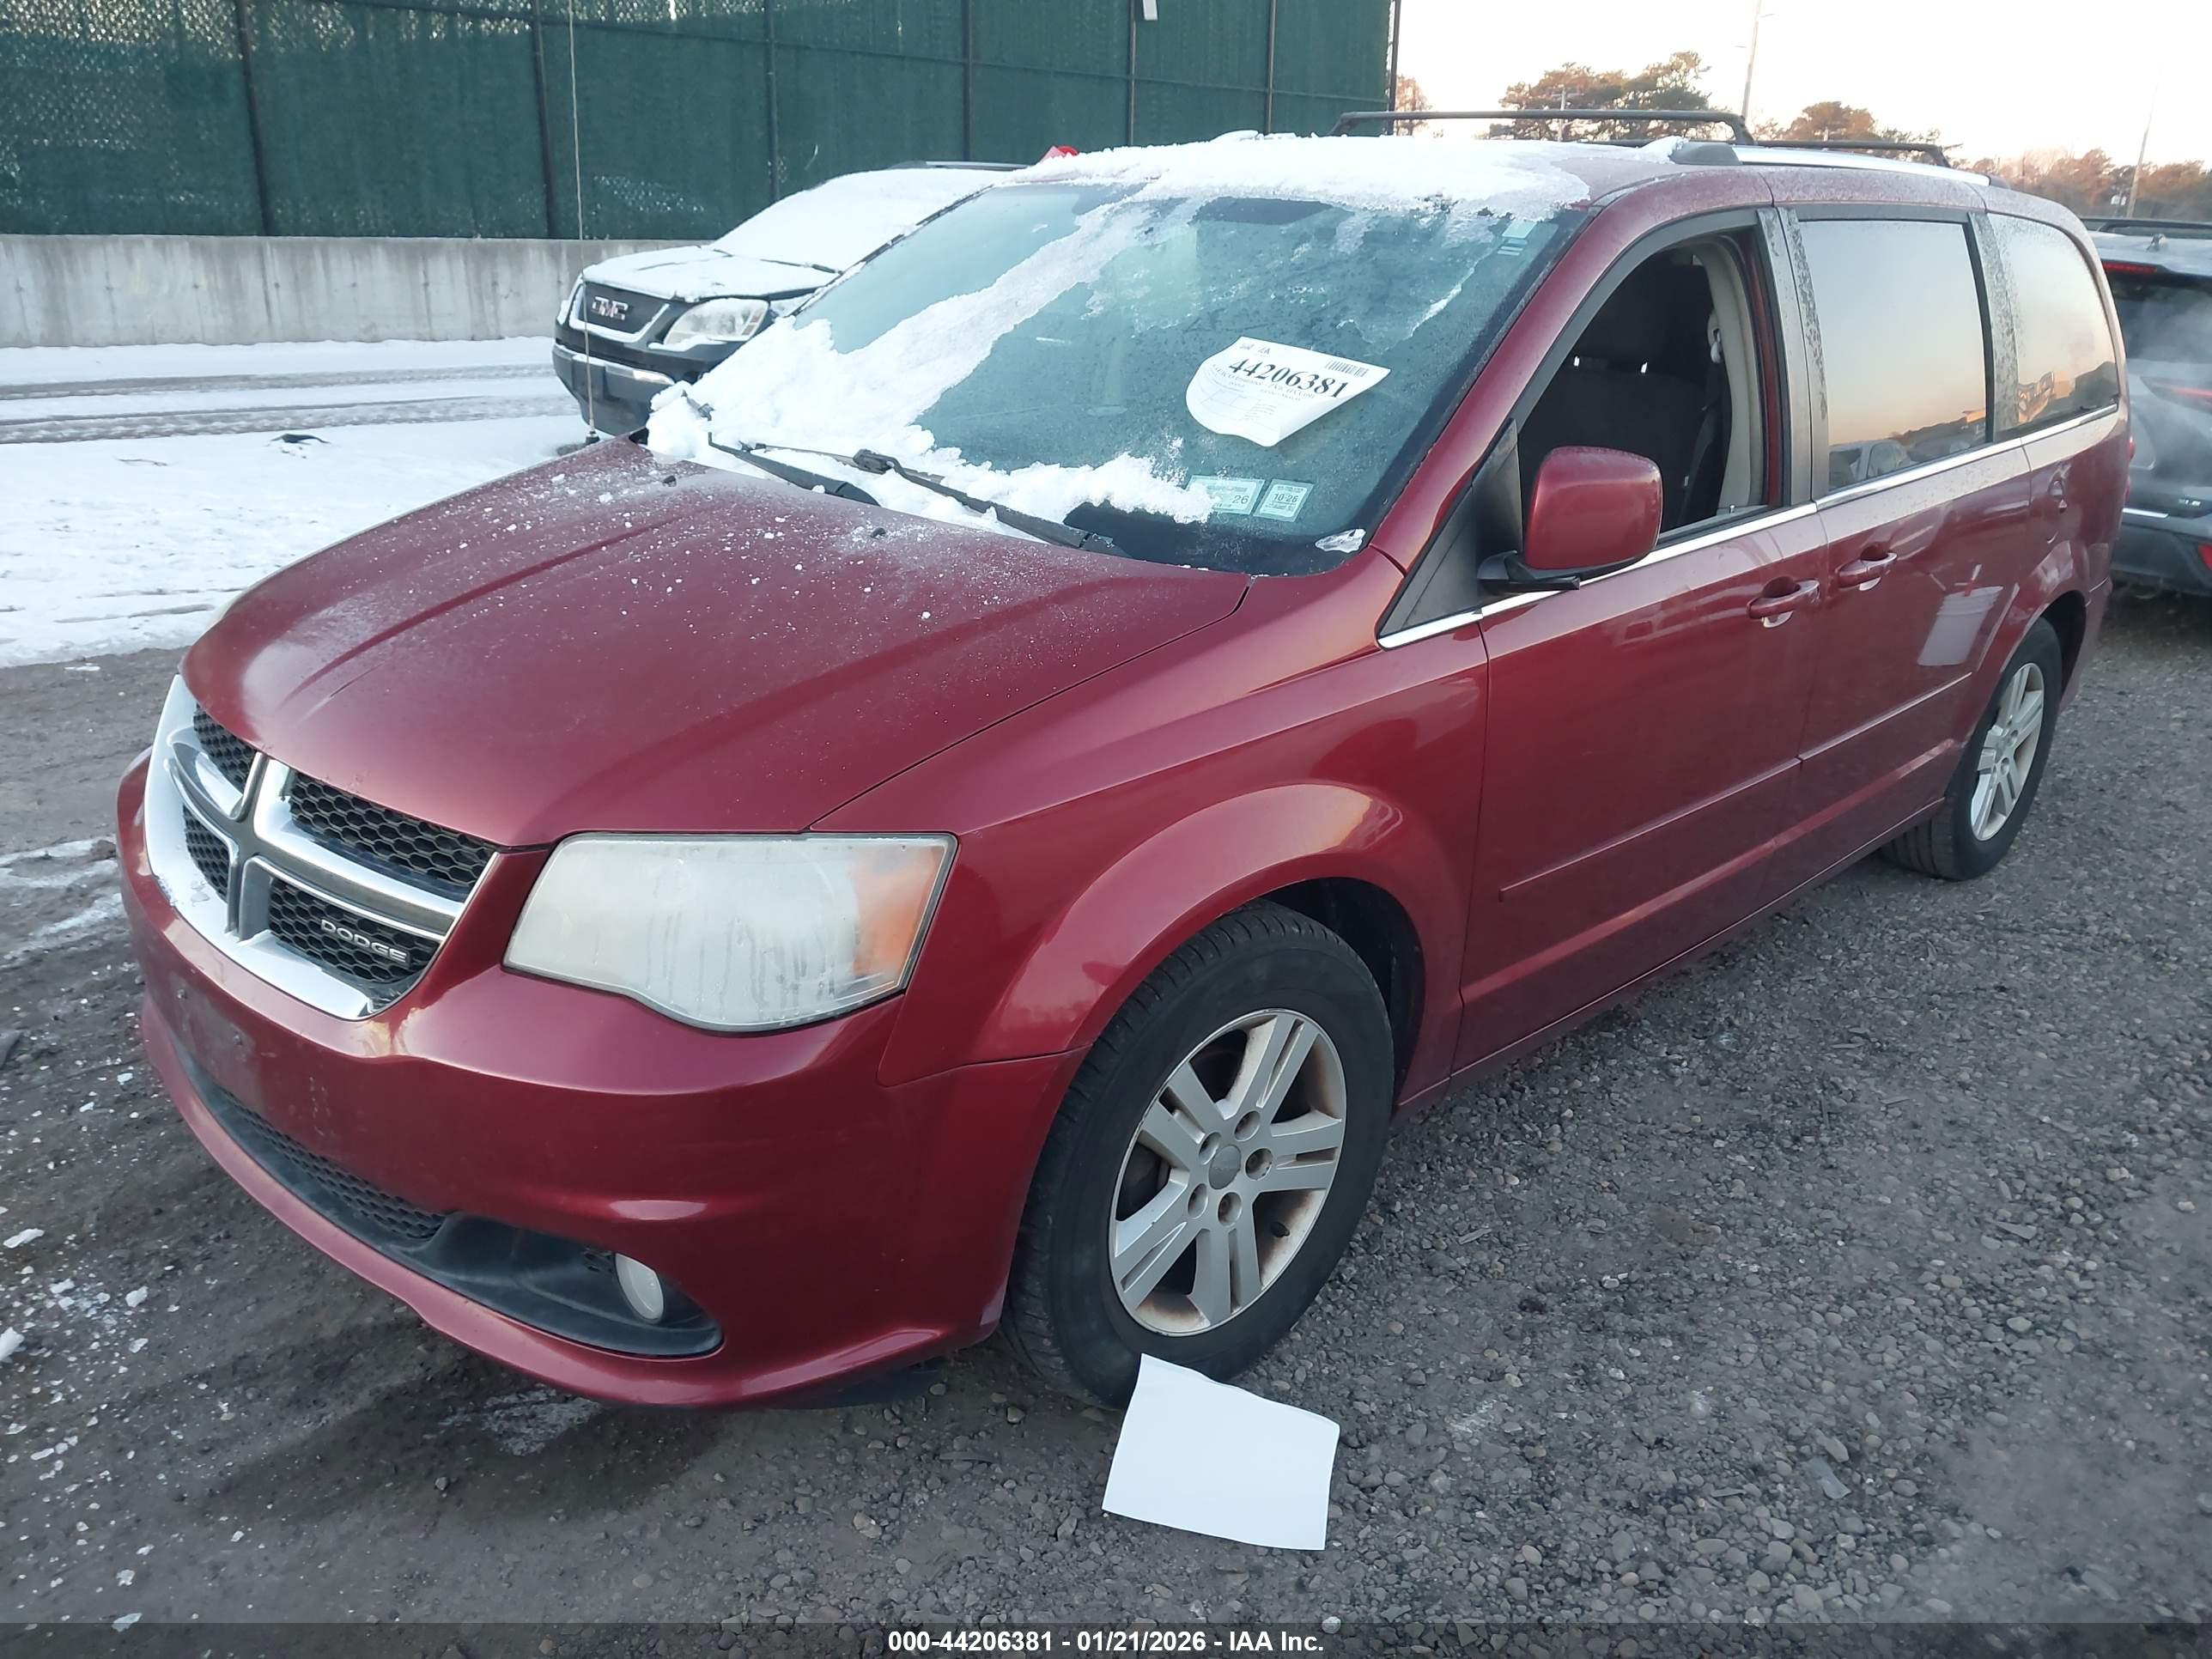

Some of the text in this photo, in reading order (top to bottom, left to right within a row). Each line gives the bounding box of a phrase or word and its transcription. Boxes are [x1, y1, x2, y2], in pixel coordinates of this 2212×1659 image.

[590, 295, 629, 321] GMC
[1228, 358, 1349, 398] 44206381
[320, 919, 407, 964] DODGE
